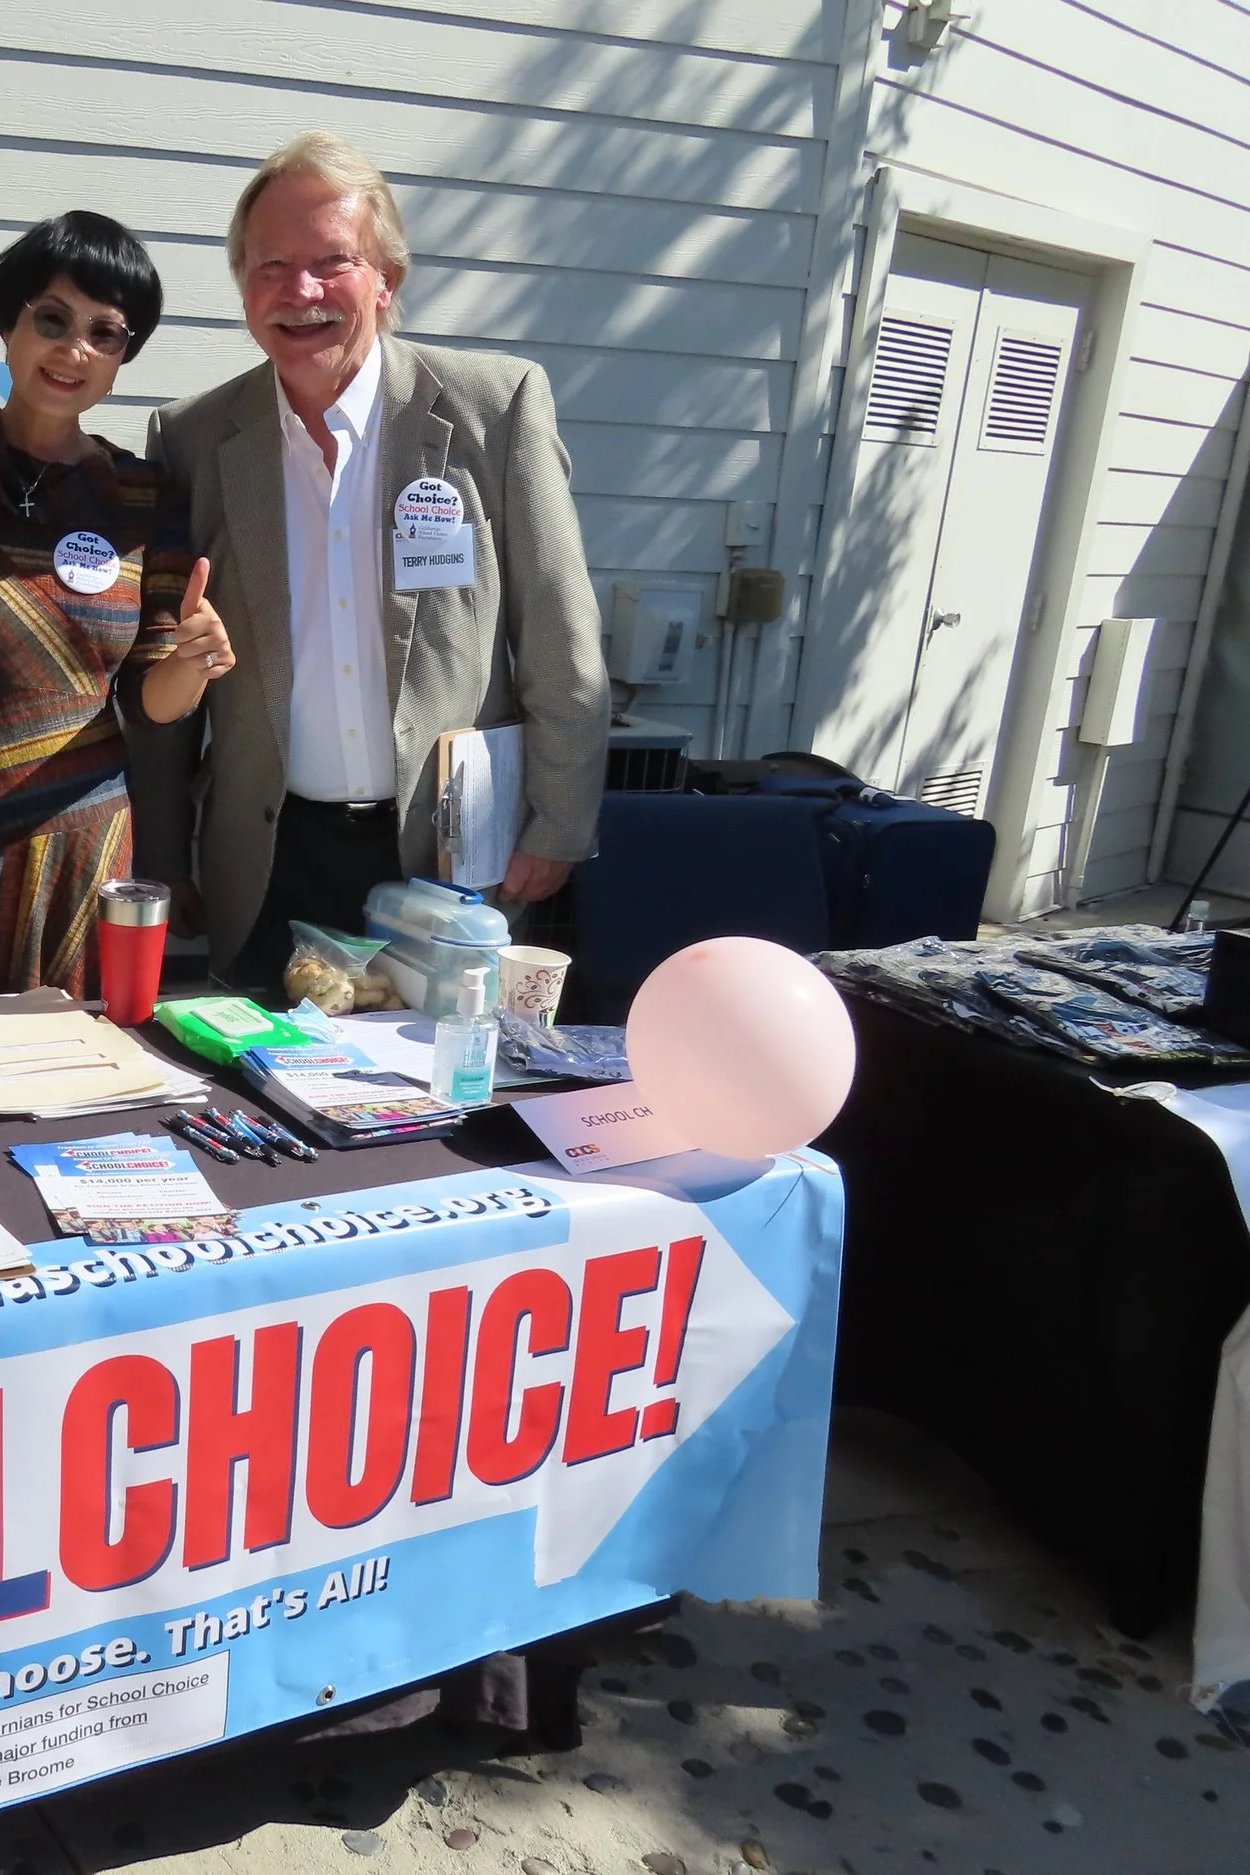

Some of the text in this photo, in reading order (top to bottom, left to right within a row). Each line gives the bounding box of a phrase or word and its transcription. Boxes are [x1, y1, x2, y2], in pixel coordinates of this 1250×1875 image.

[419, 481, 442, 491] Got
[407, 493, 458, 506] Choice?
[398, 504, 462, 516] School Choice
[404, 513, 419, 521] Ask
[77, 533, 100, 544] Got
[57, 550, 87, 562] School
[66, 541, 114, 560] Choice?
[402, 553, 465, 568] TERRY HUDGINS
[581, 1110, 635, 1127] SCHOOL
[79, 1177, 132, 1185] $14,000
[161, 1176, 189, 1184] year
[165, 1584, 308, 1658] That's
[316, 1554, 392, 1612] All!
[59, 1702, 83, 1720] for
[86, 1684, 147, 1711] School
[151, 1672, 210, 1698] Choice
[40, 1720, 104, 1754] funding
[108, 1709, 149, 1734] from
[7, 1756, 76, 1786] Broome
